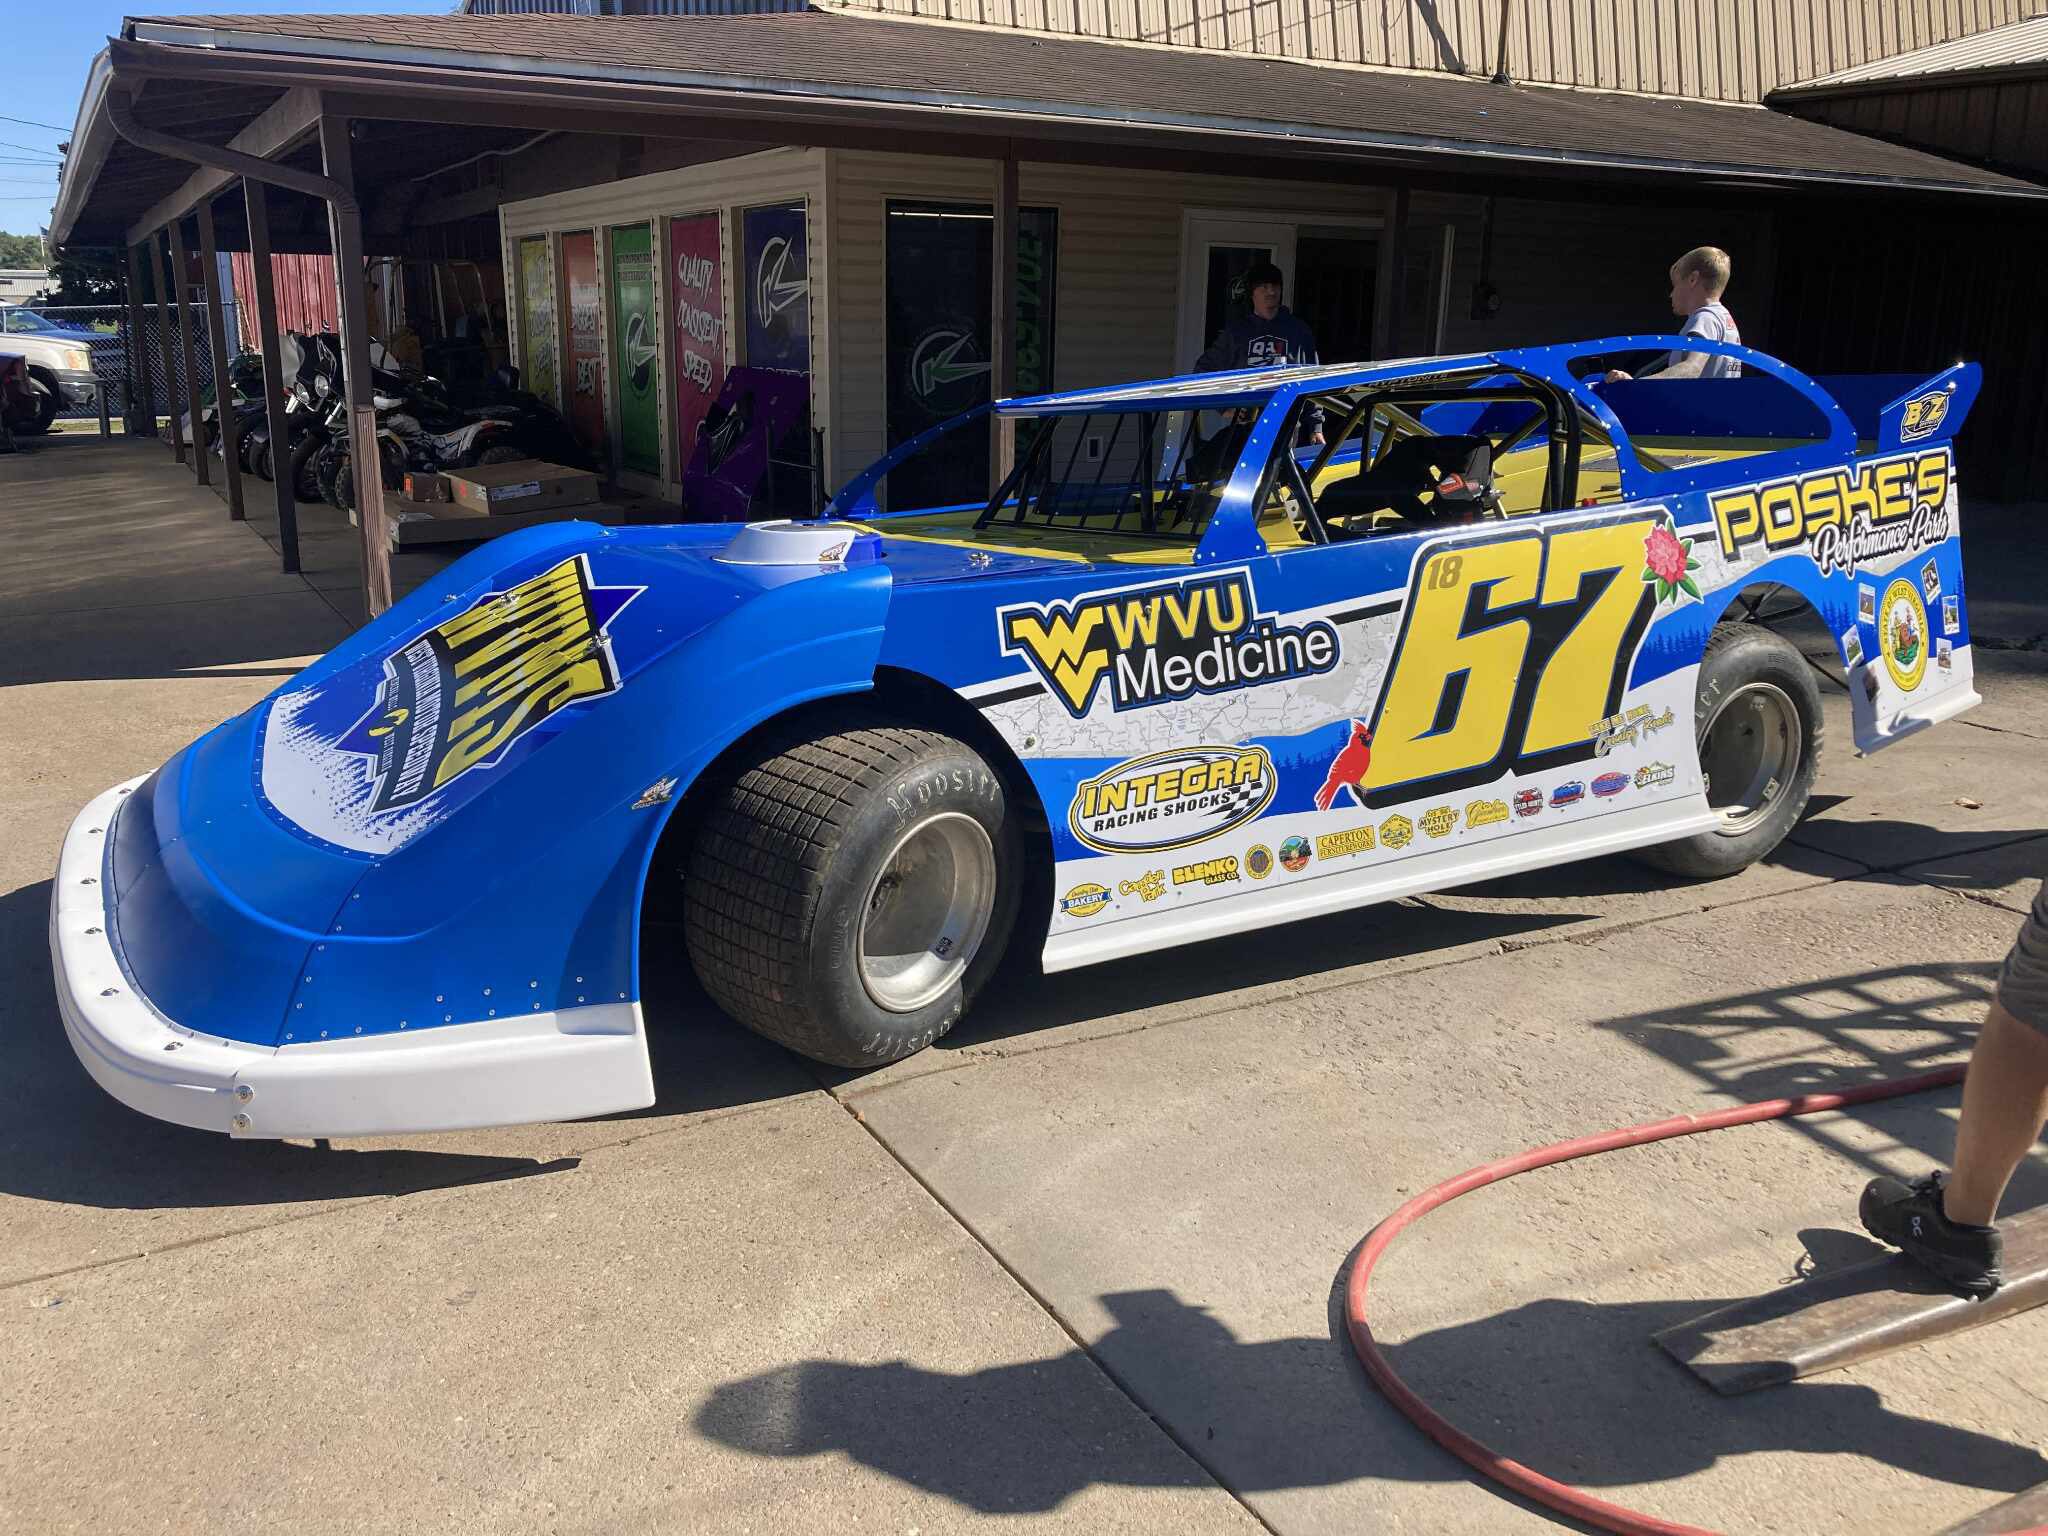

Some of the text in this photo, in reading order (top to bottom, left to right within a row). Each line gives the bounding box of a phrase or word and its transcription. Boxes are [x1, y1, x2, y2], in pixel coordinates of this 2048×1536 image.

[1714, 455, 1946, 555] POSKE'S
[1813, 501, 1949, 577] Performance Parts
[1427, 555, 1463, 591] 18
[1105, 584, 1243, 650] WVU
[1115, 627, 1332, 702] Medicine
[1361, 519, 1656, 792] 67
[390, 639, 441, 800] WEST VIRGINIA MOTOR SPEEDWAY
[1082, 753, 1263, 818] INTEGRA
[1093, 791, 1232, 832] RACING SHOCKS
[1419, 812, 1459, 827] MYSTERY
[1427, 823, 1451, 833] HOLE
[1321, 828, 1370, 848] CAPERTON
[1172, 856, 1238, 885] BLENKO
[1205, 874, 1226, 885] GLASS
[1068, 893, 1104, 908] BAKERY
[1911, 1216, 1922, 1237] DC
